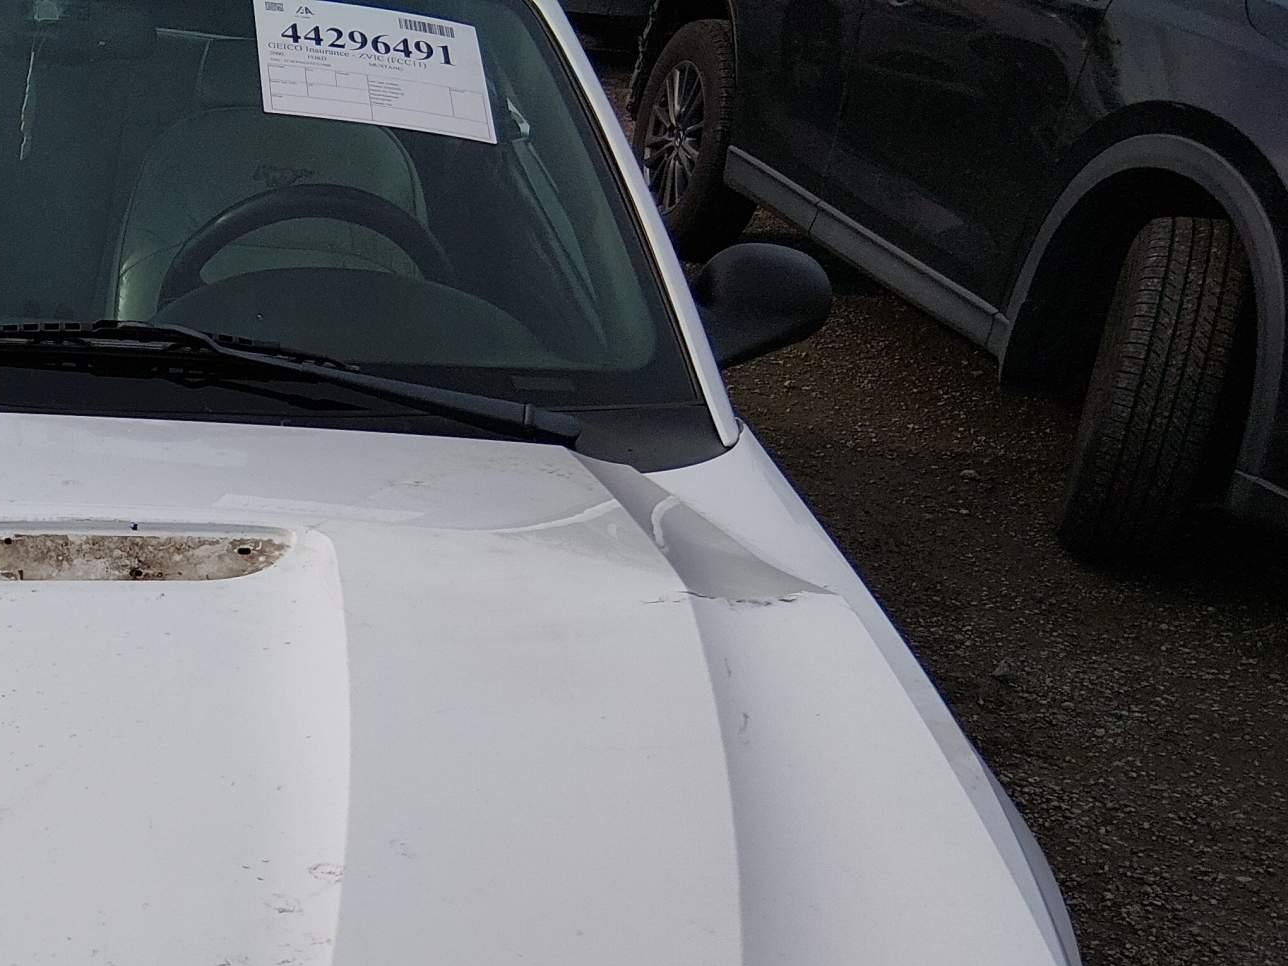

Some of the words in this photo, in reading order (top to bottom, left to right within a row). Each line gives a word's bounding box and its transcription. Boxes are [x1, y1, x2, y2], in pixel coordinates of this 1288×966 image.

[267, 41, 303, 52] GEICO
[305, 45, 350, 57] Insurance
[280, 22, 457, 67] 44296491
